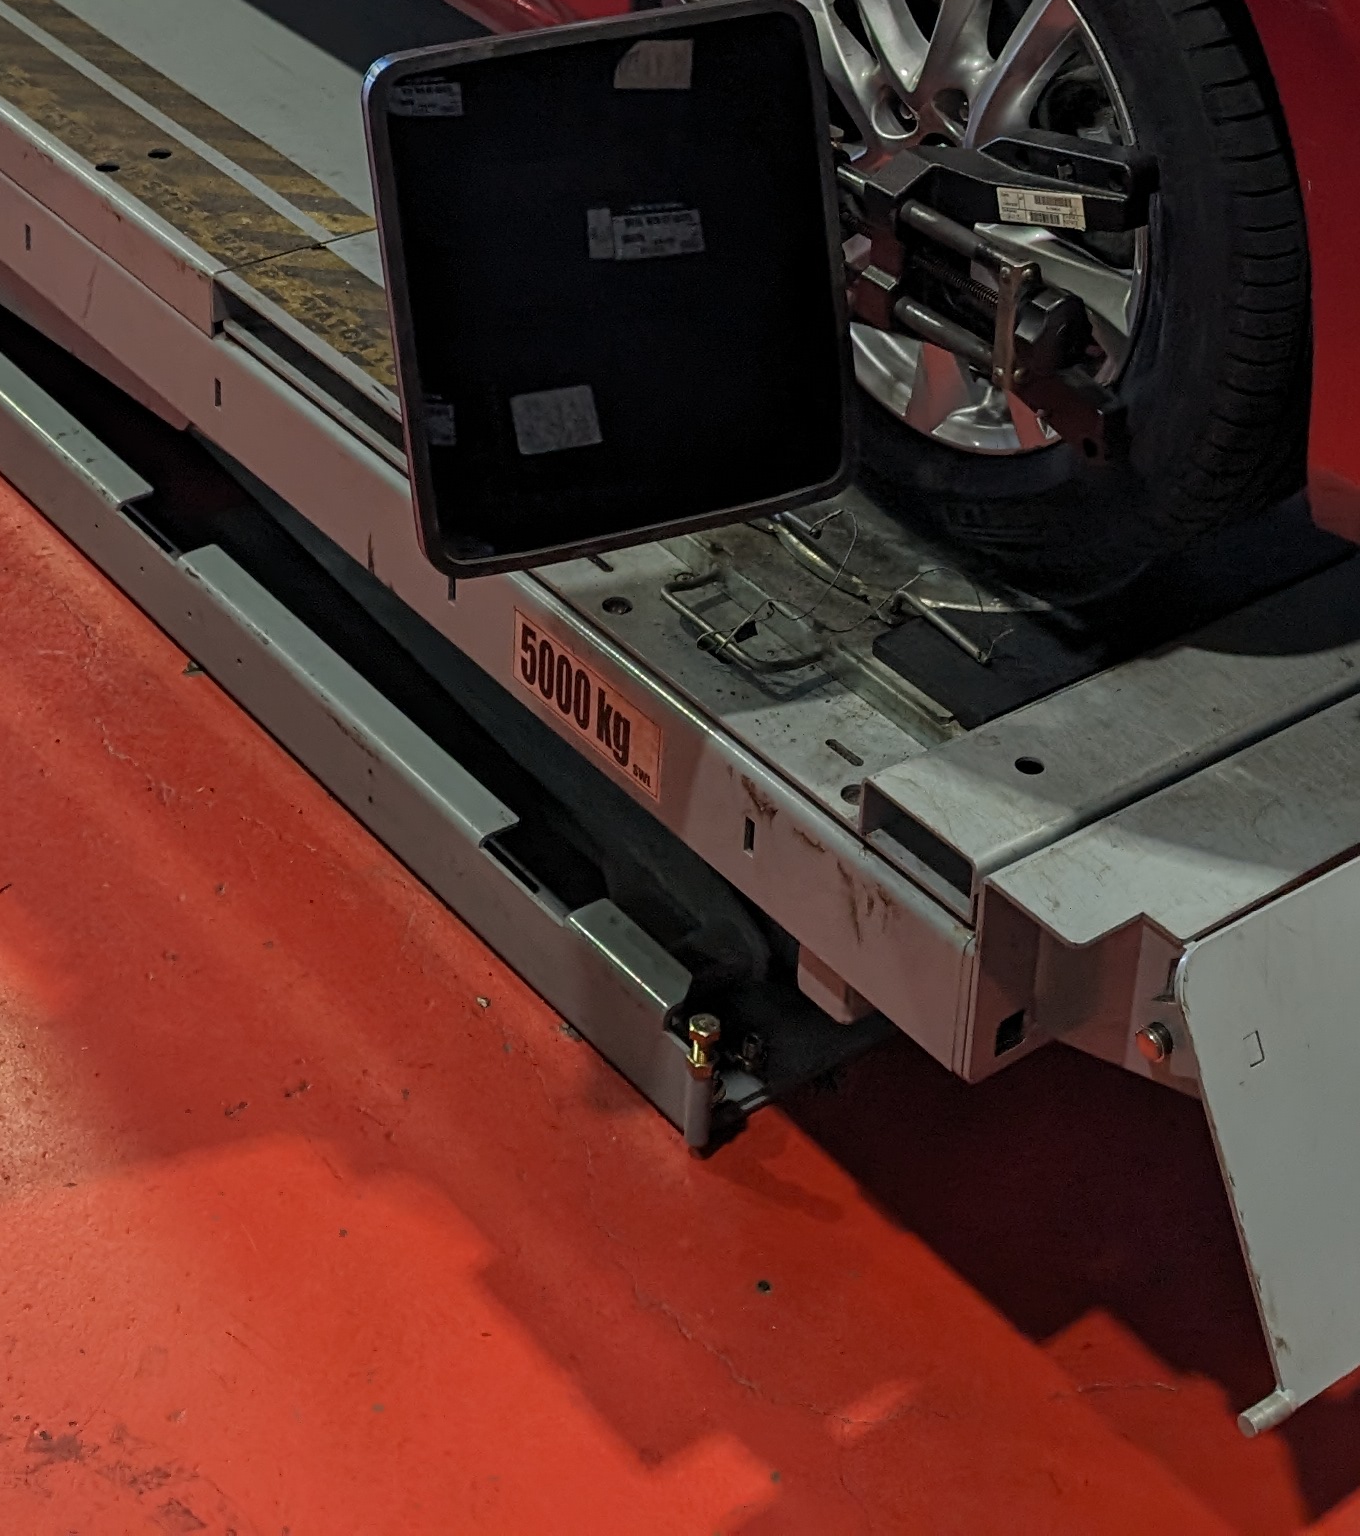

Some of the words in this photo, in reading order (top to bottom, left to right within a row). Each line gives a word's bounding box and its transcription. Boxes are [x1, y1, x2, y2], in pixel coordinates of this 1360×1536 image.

[520, 623, 591, 731] 5000
[596, 686, 631, 767] kg
[632, 763, 652, 789] SWL
